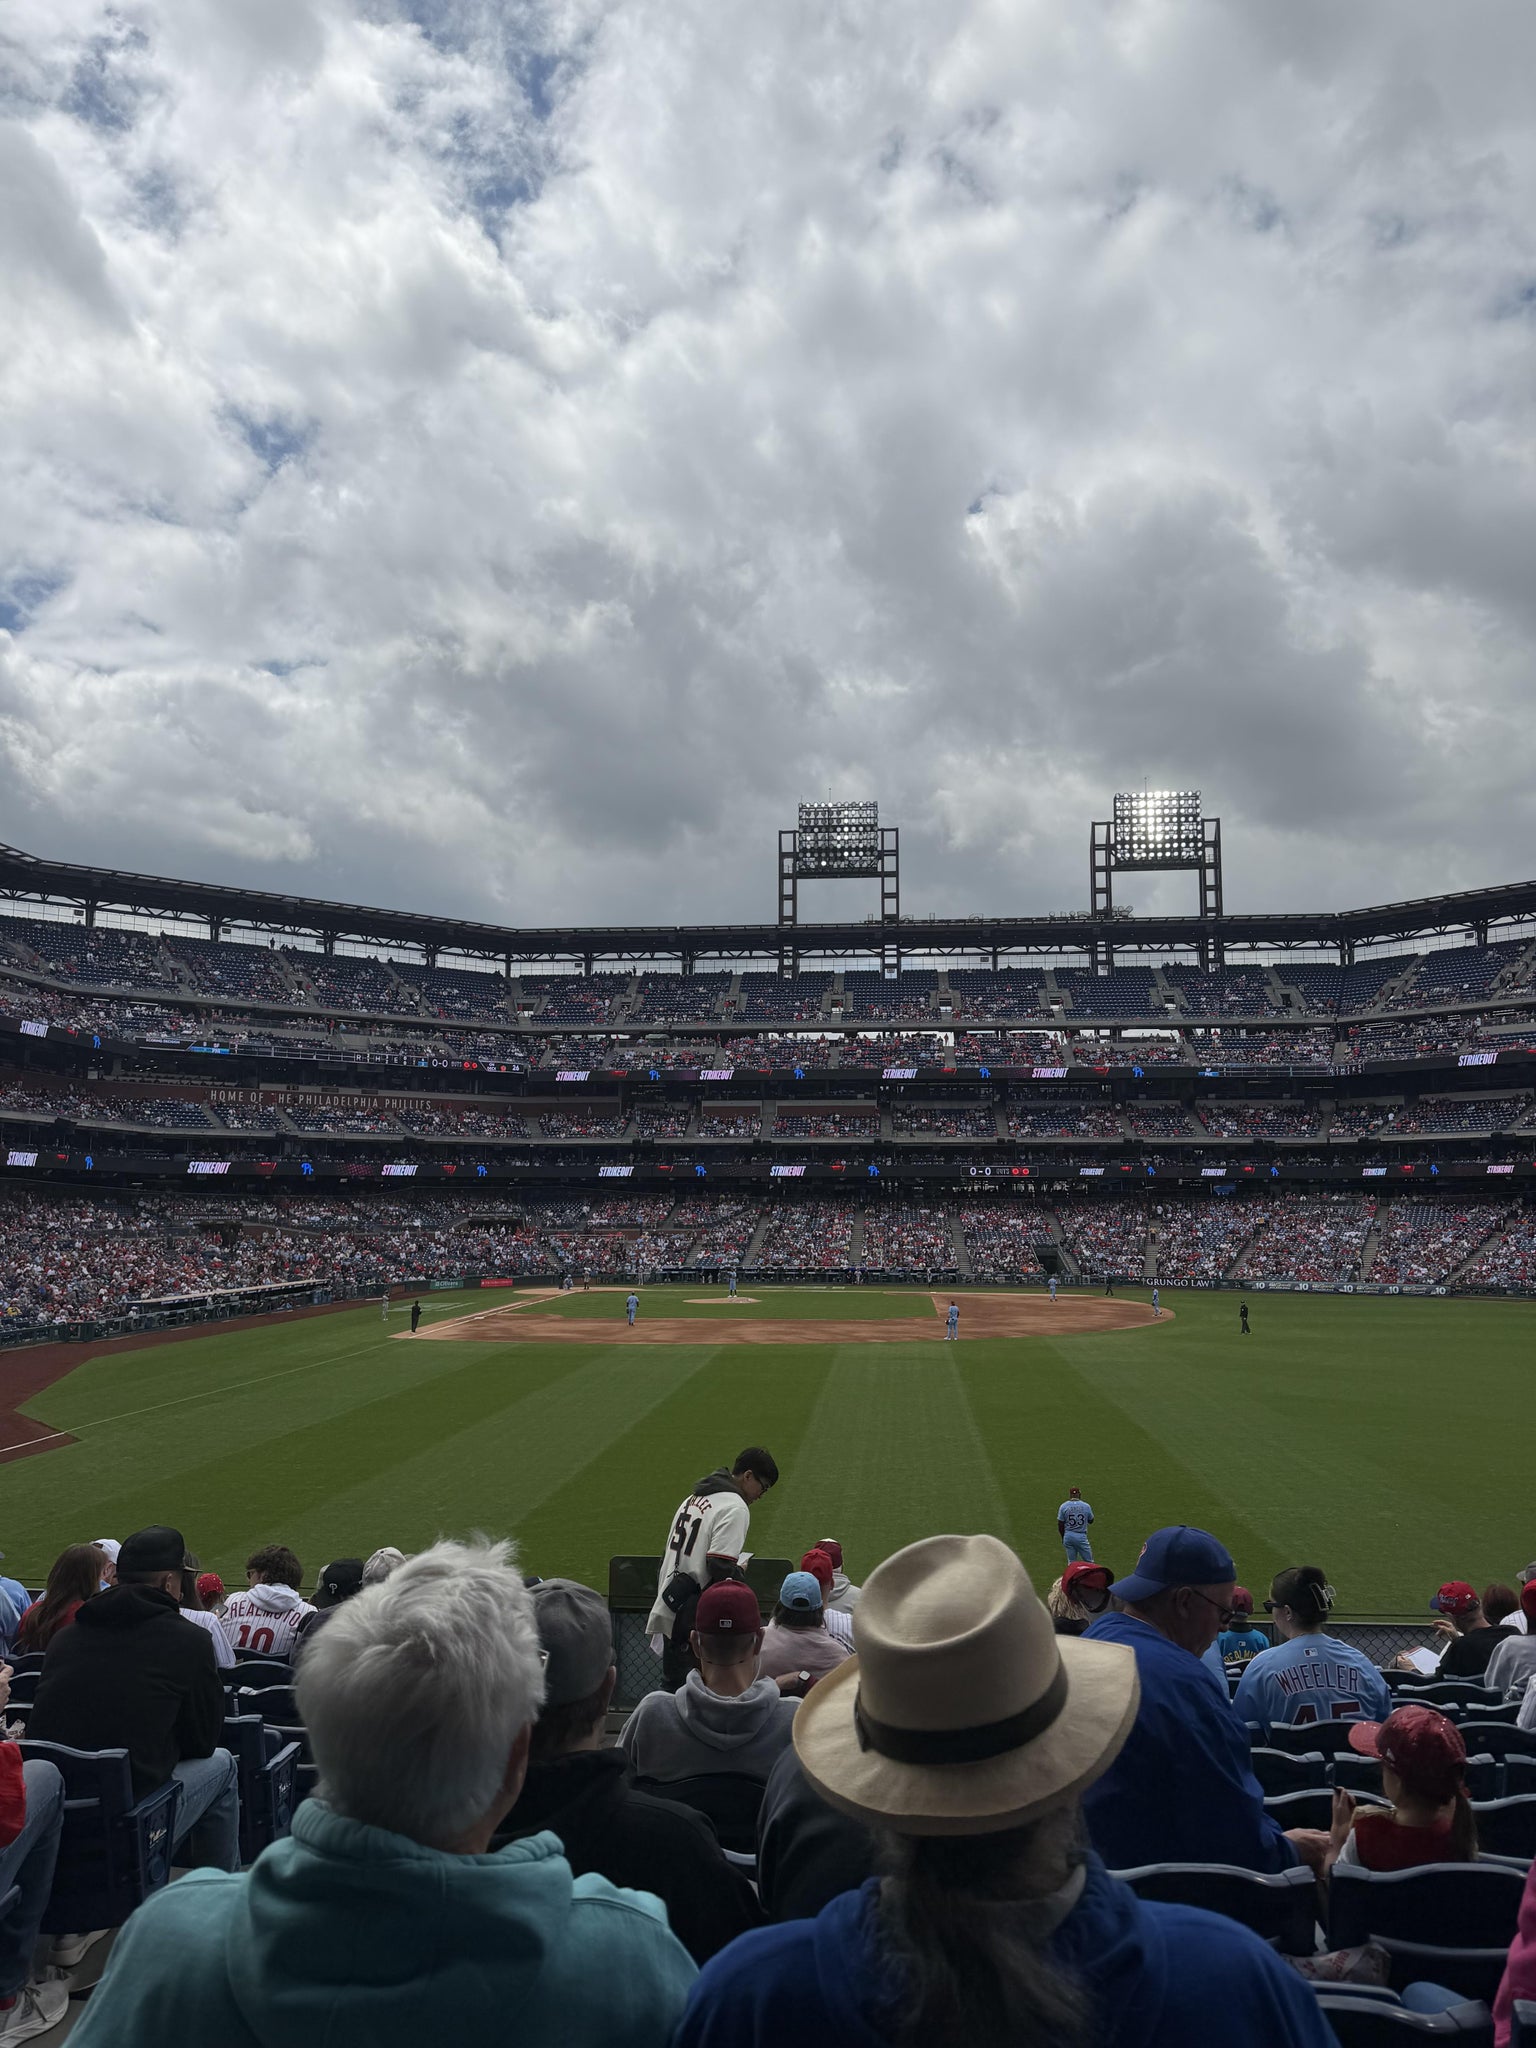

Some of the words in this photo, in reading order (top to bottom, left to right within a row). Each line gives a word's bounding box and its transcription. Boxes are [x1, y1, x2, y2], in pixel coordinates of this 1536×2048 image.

[1458, 1052, 1498, 1067] STRIKEOUT
[555, 1071, 590, 1081] STRIKEOUT
[700, 1070, 734, 1080] STRIKEOUT
[882, 1069, 918, 1079] STRIKEOUT
[1032, 1068, 1069, 1078] STRIKEOUT
[210, 1090, 244, 1102] HOME
[250, 1092, 264, 1102] OF
[299, 1094, 378, 1108] PHILADELPHIA
[187, 1161, 231, 1174] STRIKEOUT
[381, 1165, 418, 1176] STRIKEOUT
[599, 1166, 634, 1177] STRIKEOUT
[770, 1166, 806, 1177] STRIKEOUT
[1146, 1278, 1188, 1287] GRUNGO
[1191, 1279, 1210, 1287] LAW
[1068, 1513, 1085, 1526] 53
[670, 1512, 702, 1556] 51
[239, 1624, 275, 1654] 10
[1274, 1662, 1359, 1697] WHEELER
